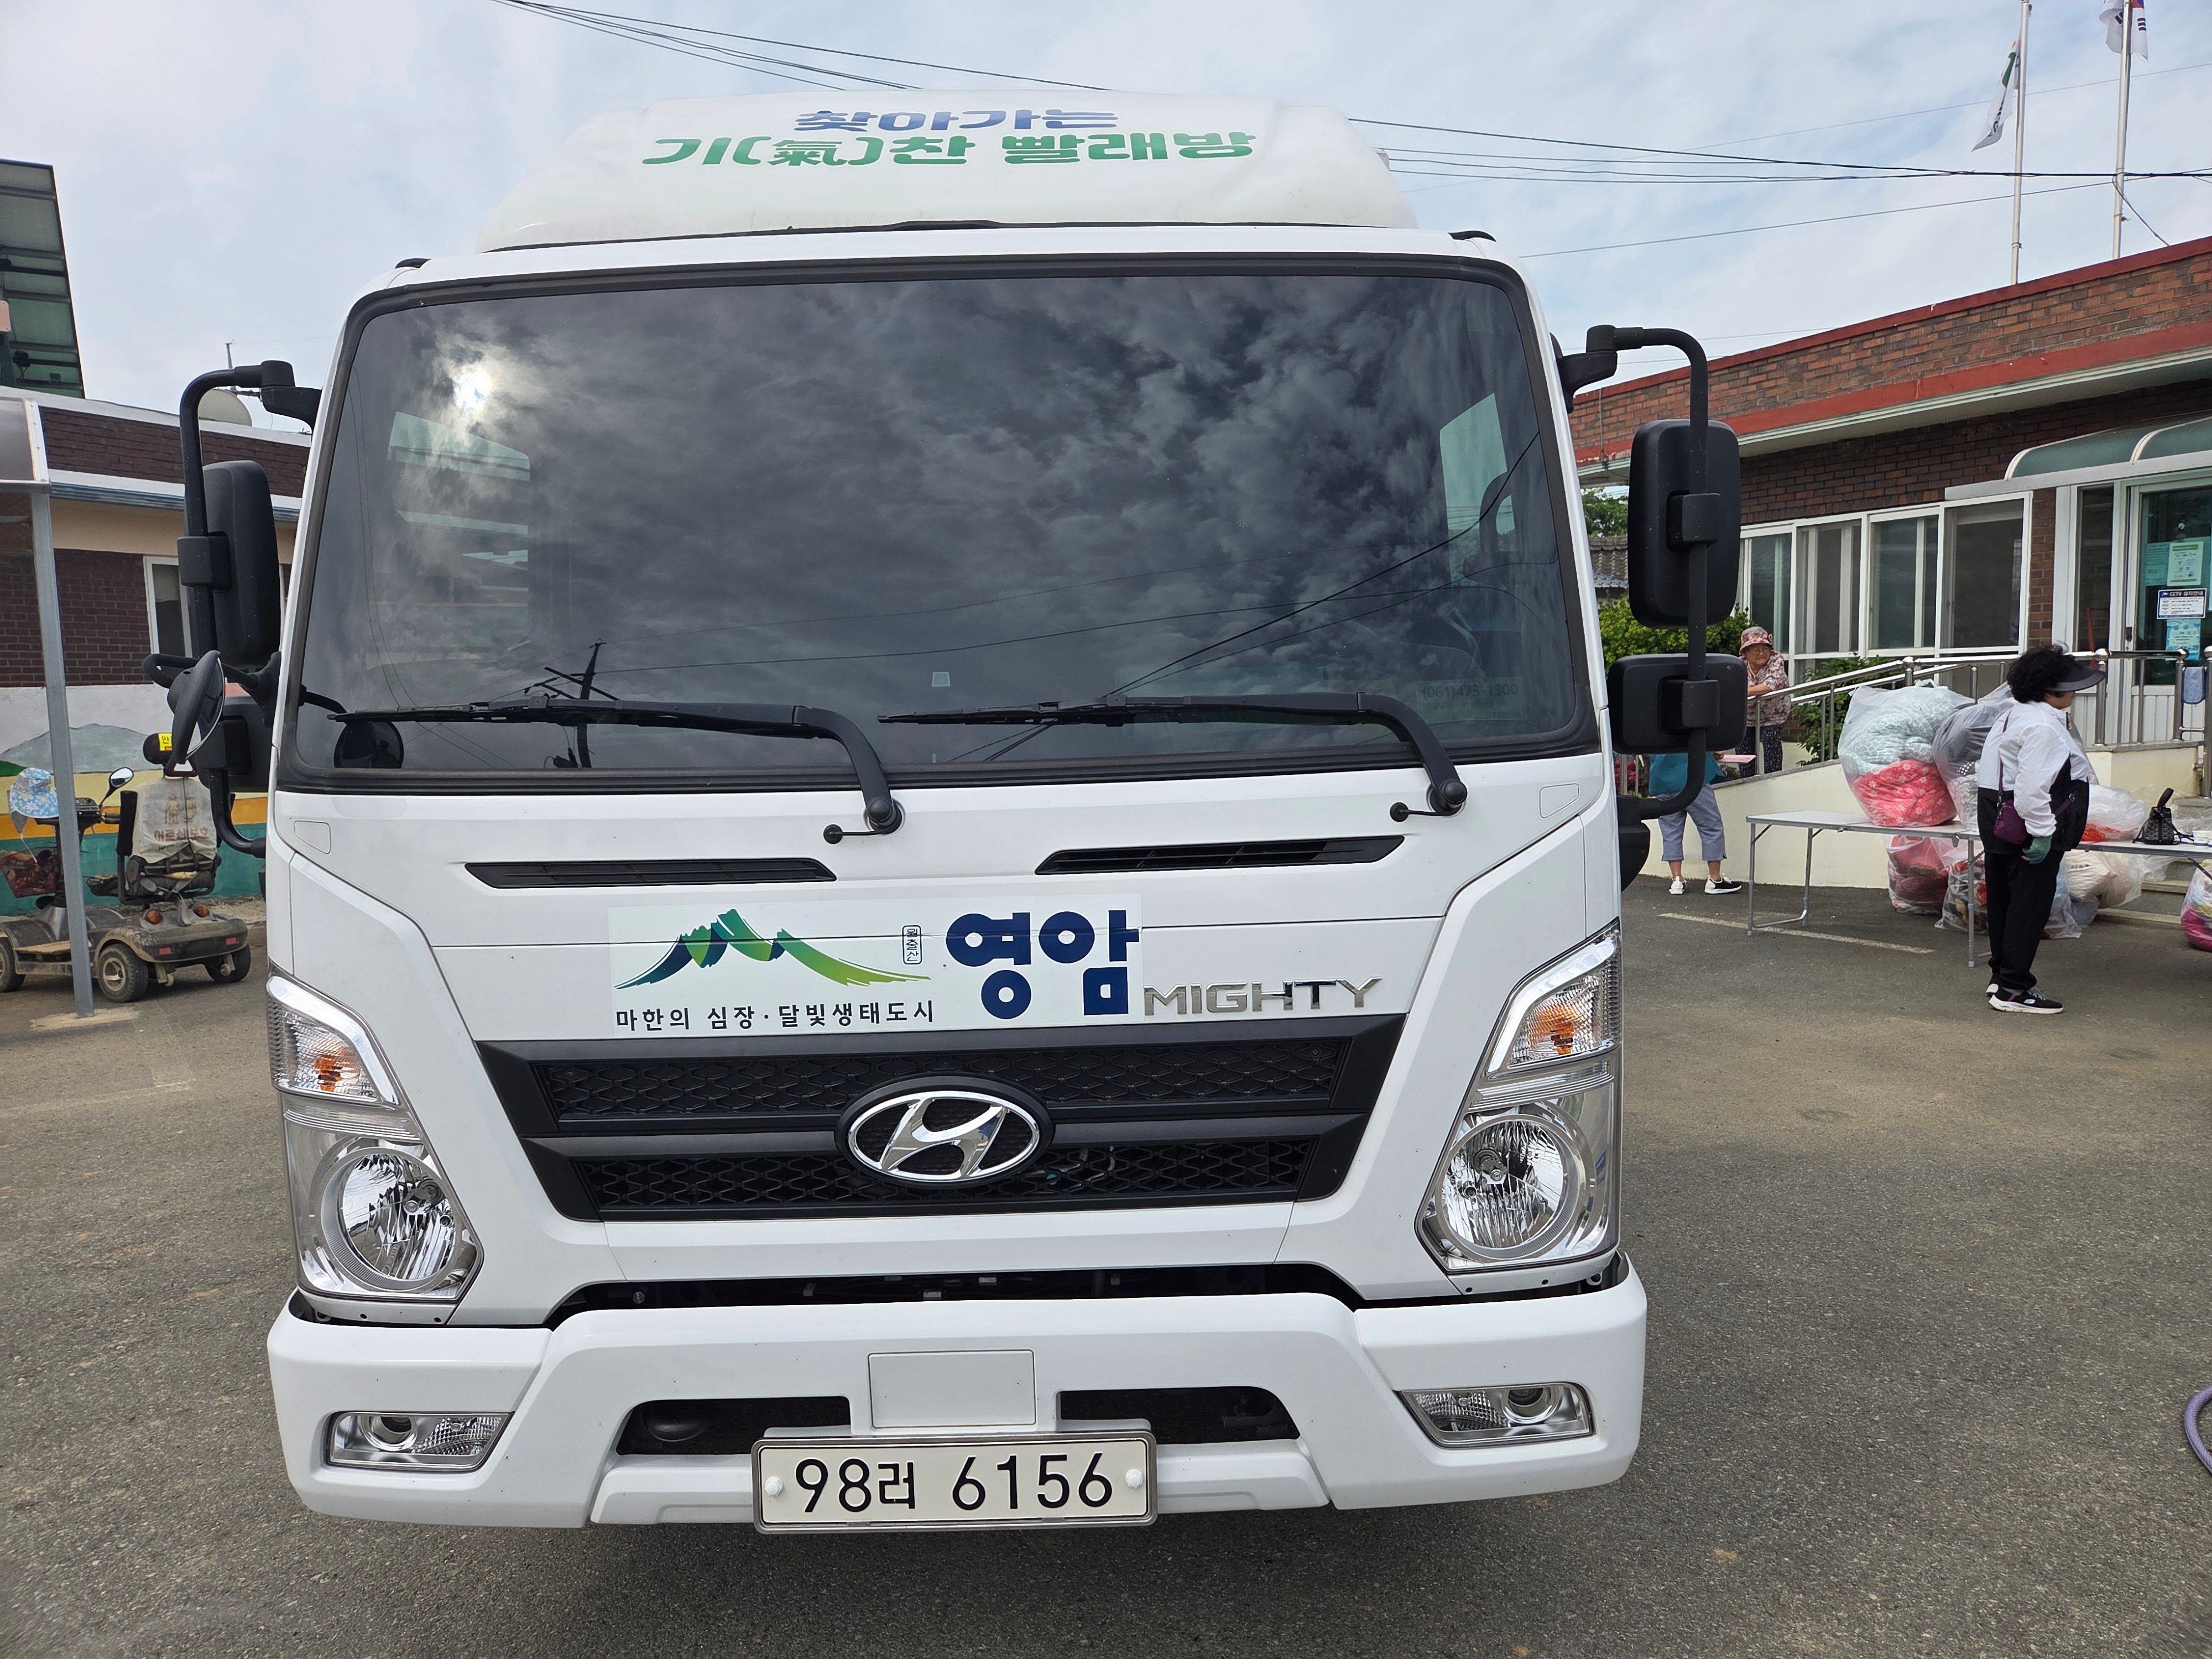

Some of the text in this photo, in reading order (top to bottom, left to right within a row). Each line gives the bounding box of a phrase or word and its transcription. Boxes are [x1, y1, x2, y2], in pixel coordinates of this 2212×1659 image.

[794, 110, 1118, 132] 찾아가는
[642, 132, 1256, 166] 기(氣)찬 빨래방
[154, 829, 187, 841] 어르신
[945, 910, 1139, 1020] 영암
[1144, 976, 1383, 1016] MIGHTY
[616, 1008, 690, 1031] 마한의
[795, 1452, 1113, 1513] 98러 6156
